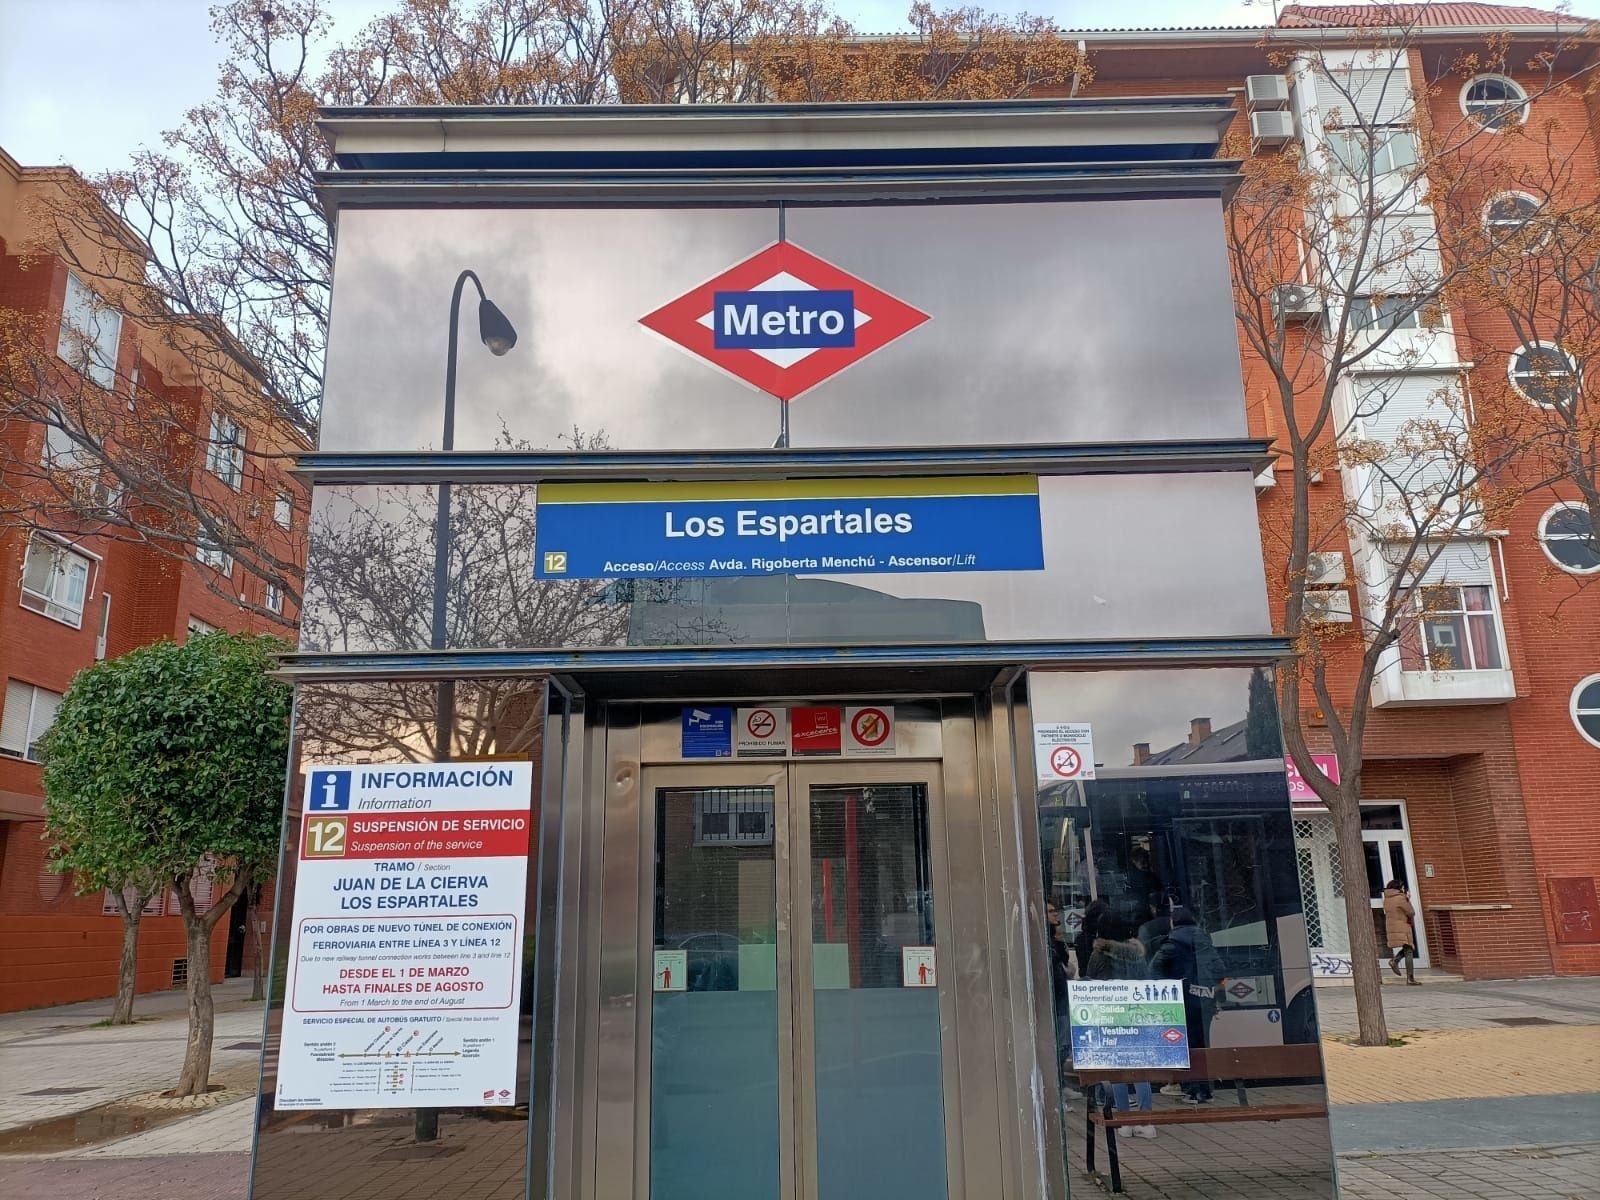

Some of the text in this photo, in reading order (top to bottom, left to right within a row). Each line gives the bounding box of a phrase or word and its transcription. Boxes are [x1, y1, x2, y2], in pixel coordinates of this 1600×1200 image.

[724, 304, 844, 335] Metro
[665, 507, 913, 541] Los Espartales
[545, 554, 565, 571] 12
[604, 557, 705, 572] Acceso/Access
[709, 558, 747, 570] Avda.
[751, 556, 818, 571] Rigoberta
[822, 555, 875, 568] Menchú
[888, 554, 976, 567] Ascensor/Lift
[361, 766, 513, 788] INFORMACIÓN
[358, 798, 432, 810] Information
[353, 818, 525, 833] SUSPENSIÓN DE SERVICIO
[309, 822, 344, 852] 12
[351, 840, 483, 852] Suspension of the service
[374, 862, 414, 872] TRAMO
[333, 876, 488, 891] JUAN DE LA CIERVA
[341, 894, 478, 910] LOS ESPARTALES
[304, 920, 512, 933] POR OBRAS DE NUEVO TÚNEL DE CONEXIÓN
[313, 936, 501, 949] FERROVIARIA ENTRE LÍNEA 3 Y LÍNEA 12
[339, 967, 469, 978] DESDE EL 1 DE MARZO
[323, 982, 484, 994] HASTA FINALES DE AGOSTO
[1090, 985, 1128, 993] preferente
[440, 997, 464, 1005] August
[1081, 1009, 1088, 1020] 0
[1080, 1030, 1092, 1043] -1
